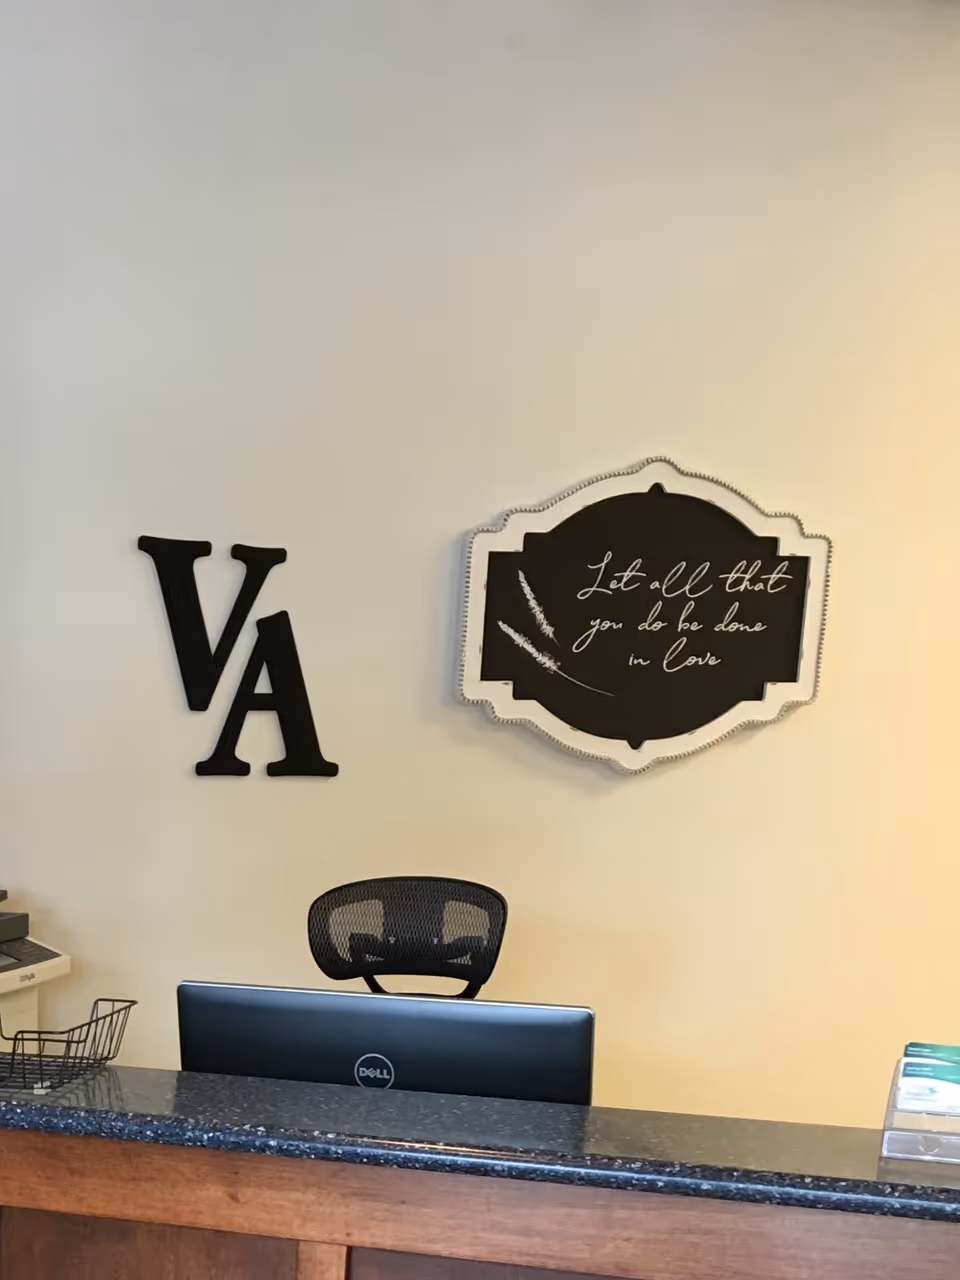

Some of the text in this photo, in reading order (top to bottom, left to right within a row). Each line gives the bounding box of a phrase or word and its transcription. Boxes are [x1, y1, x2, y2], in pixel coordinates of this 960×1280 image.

[577, 551, 793, 600] Let all that
[572, 601, 768, 653] you do be done
[138, 535, 339, 777] VA
[629, 652, 650, 667] in
[360, 1067, 390, 1079] DELL
